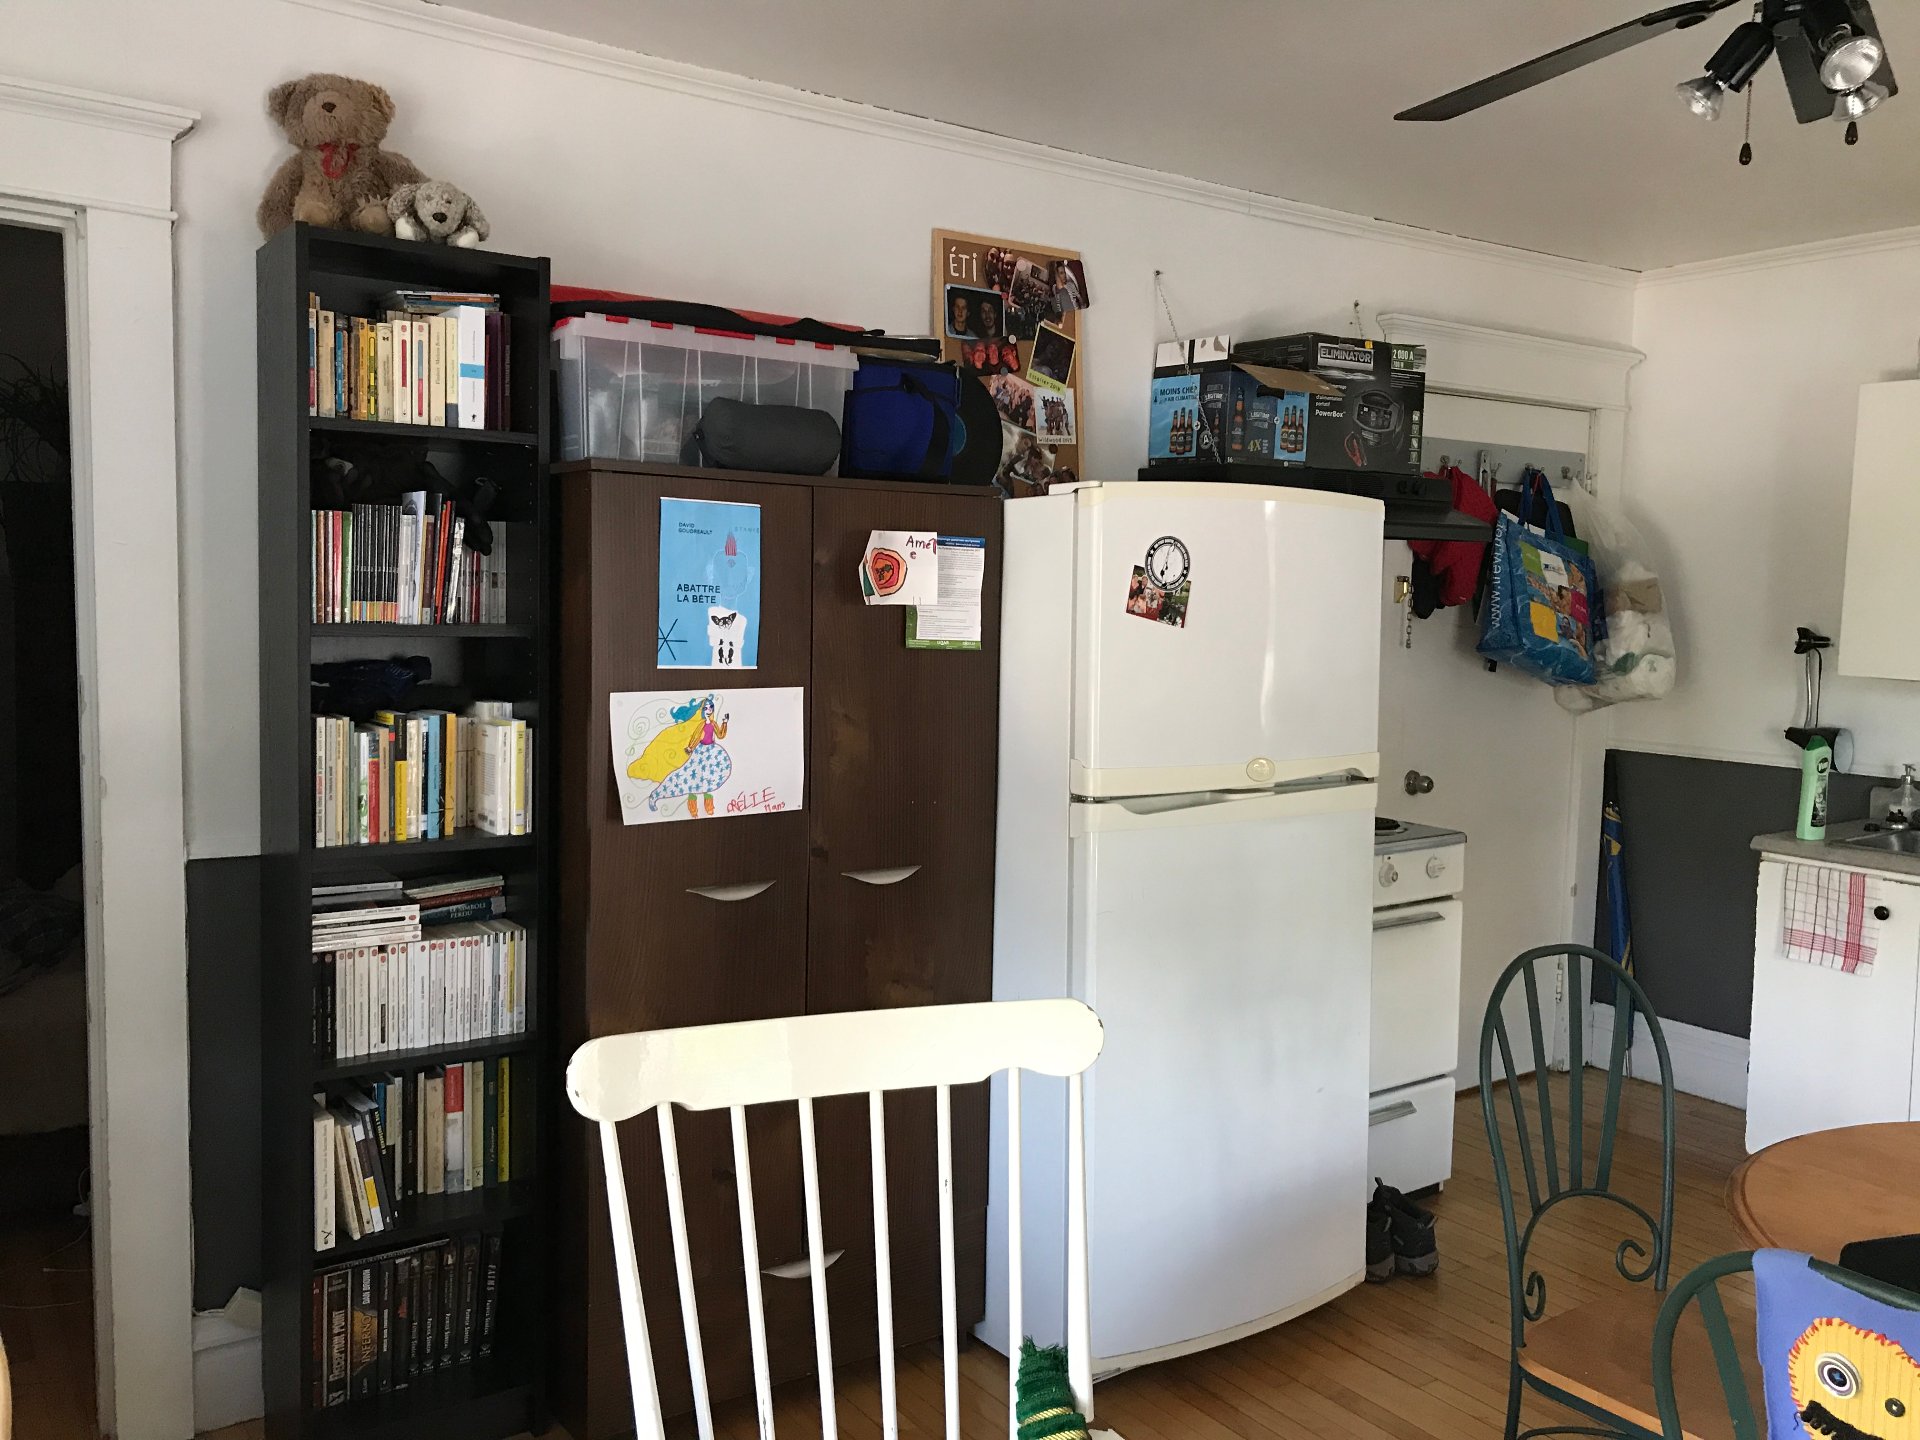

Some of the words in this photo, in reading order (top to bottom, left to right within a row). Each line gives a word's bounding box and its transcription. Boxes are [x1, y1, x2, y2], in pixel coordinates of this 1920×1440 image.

[1320, 348, 1371, 363] ELIMINATOR
[1159, 388, 1181, 397] MOINS
[1315, 409, 1344, 418] PowerBox
[676, 583, 721, 594] ABATTRE
[676, 594, 690, 603] LA
[691, 593, 717, 604] BÊTE
[331, 1310, 346, 1334] POINT
[360, 1315, 372, 1363] INFERNO
[328, 1334, 346, 1382] DECEPTION
